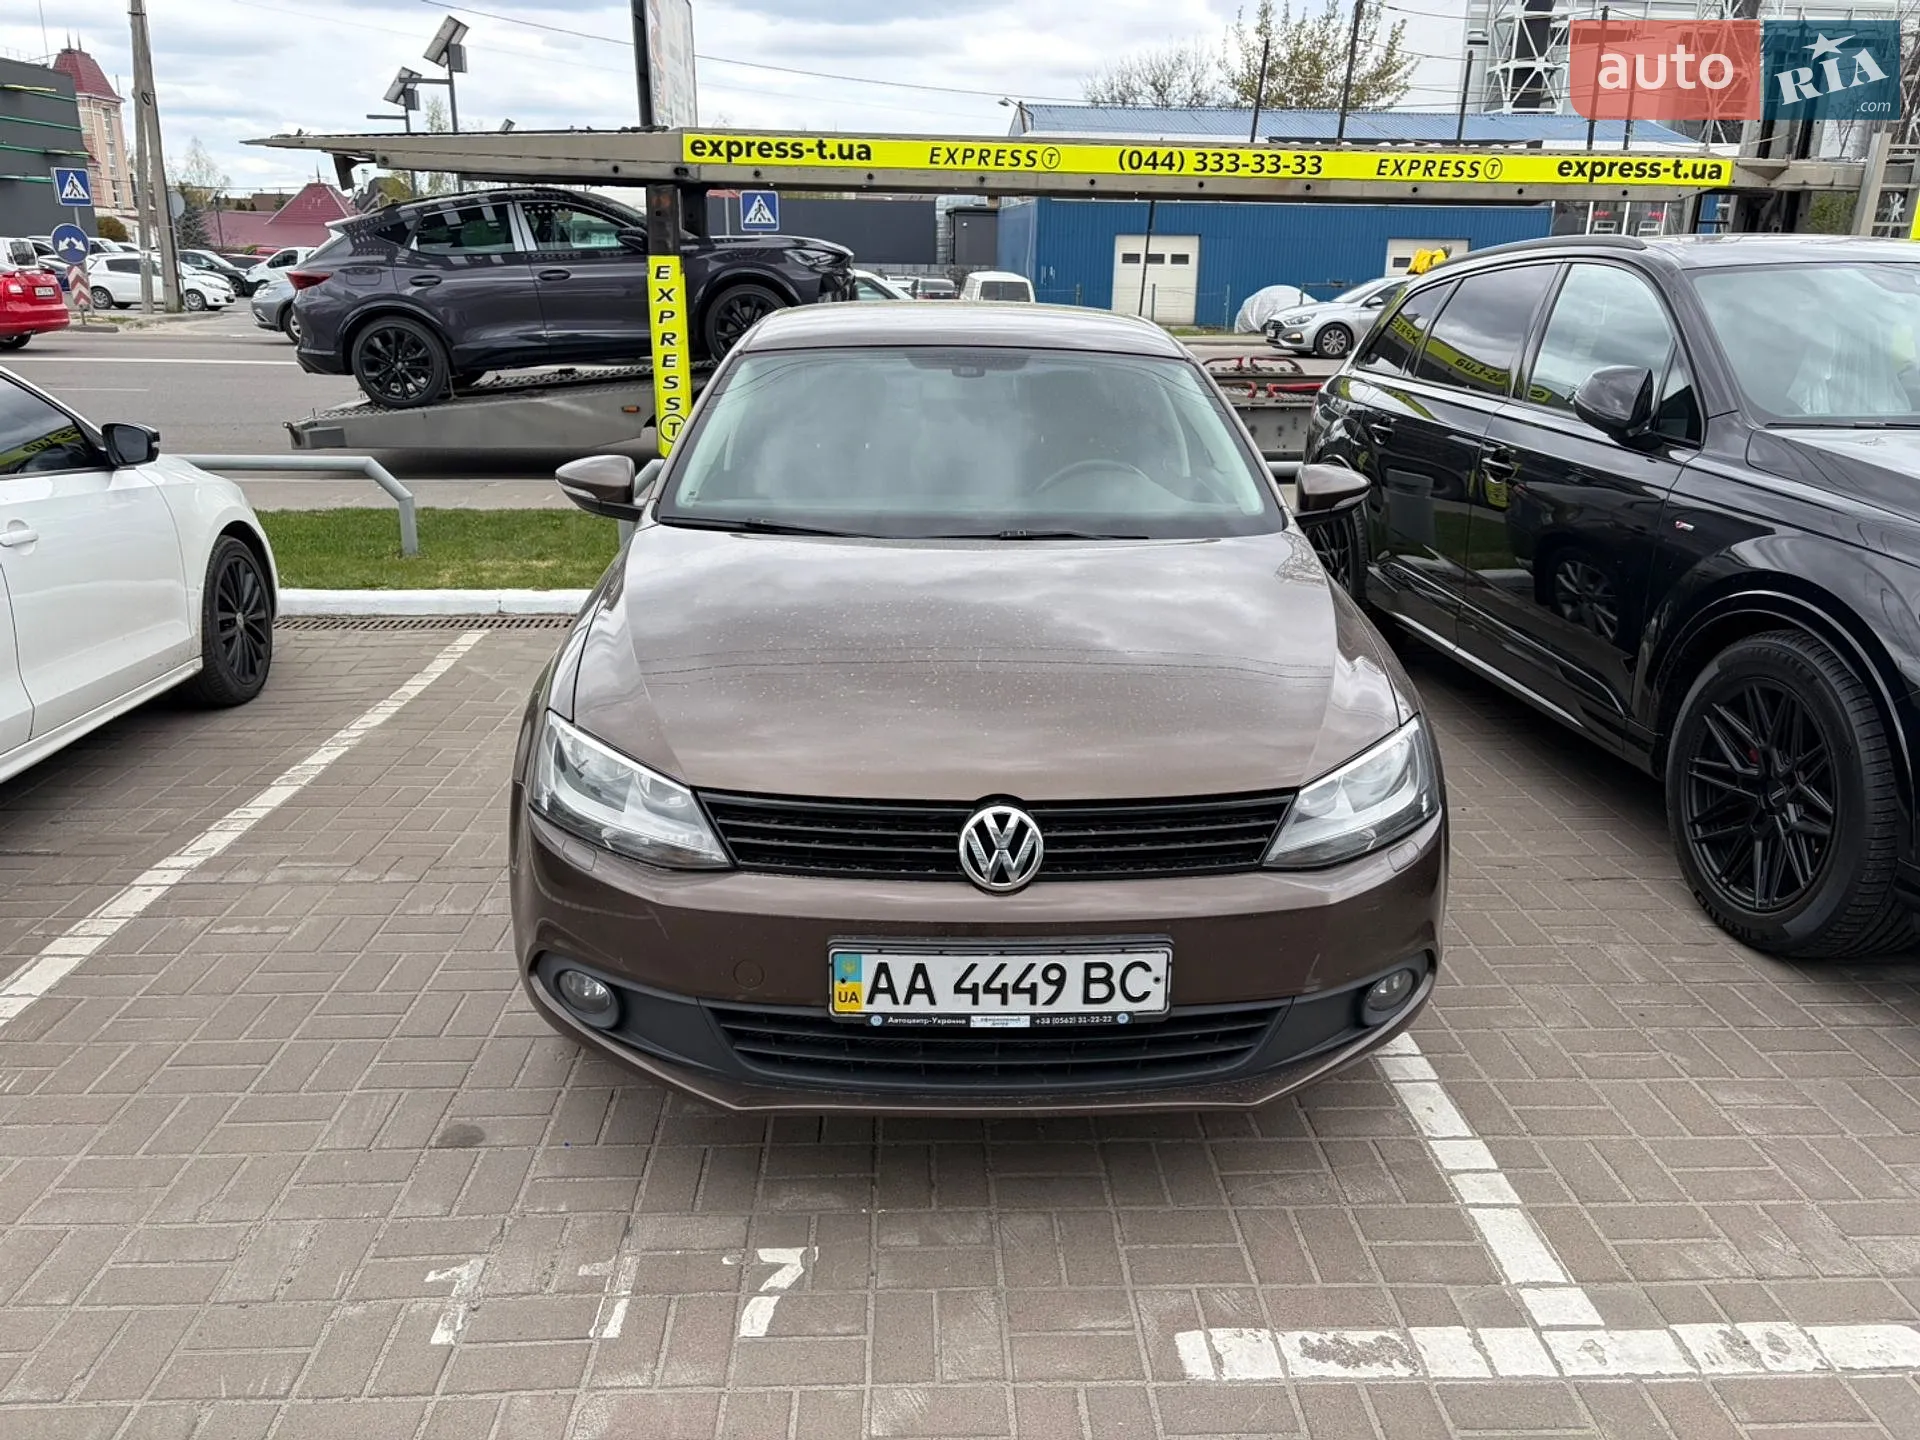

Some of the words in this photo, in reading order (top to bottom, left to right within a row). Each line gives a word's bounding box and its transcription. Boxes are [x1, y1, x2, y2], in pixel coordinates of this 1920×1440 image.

[690, 137, 871, 162] express-t.ua
[929, 147, 1038, 168] EXPRESS
[1118, 149, 1184, 172] (044)
[1193, 152, 1323, 175] 333-33-33
[1376, 158, 1480, 178] EXPRESS
[1557, 159, 1722, 182] express-t.ua
[866, 962, 937, 1006] AA
[953, 962, 1067, 1006] 4449
[1083, 961, 1152, 1005] BC
[838, 990, 859, 1004] UA
